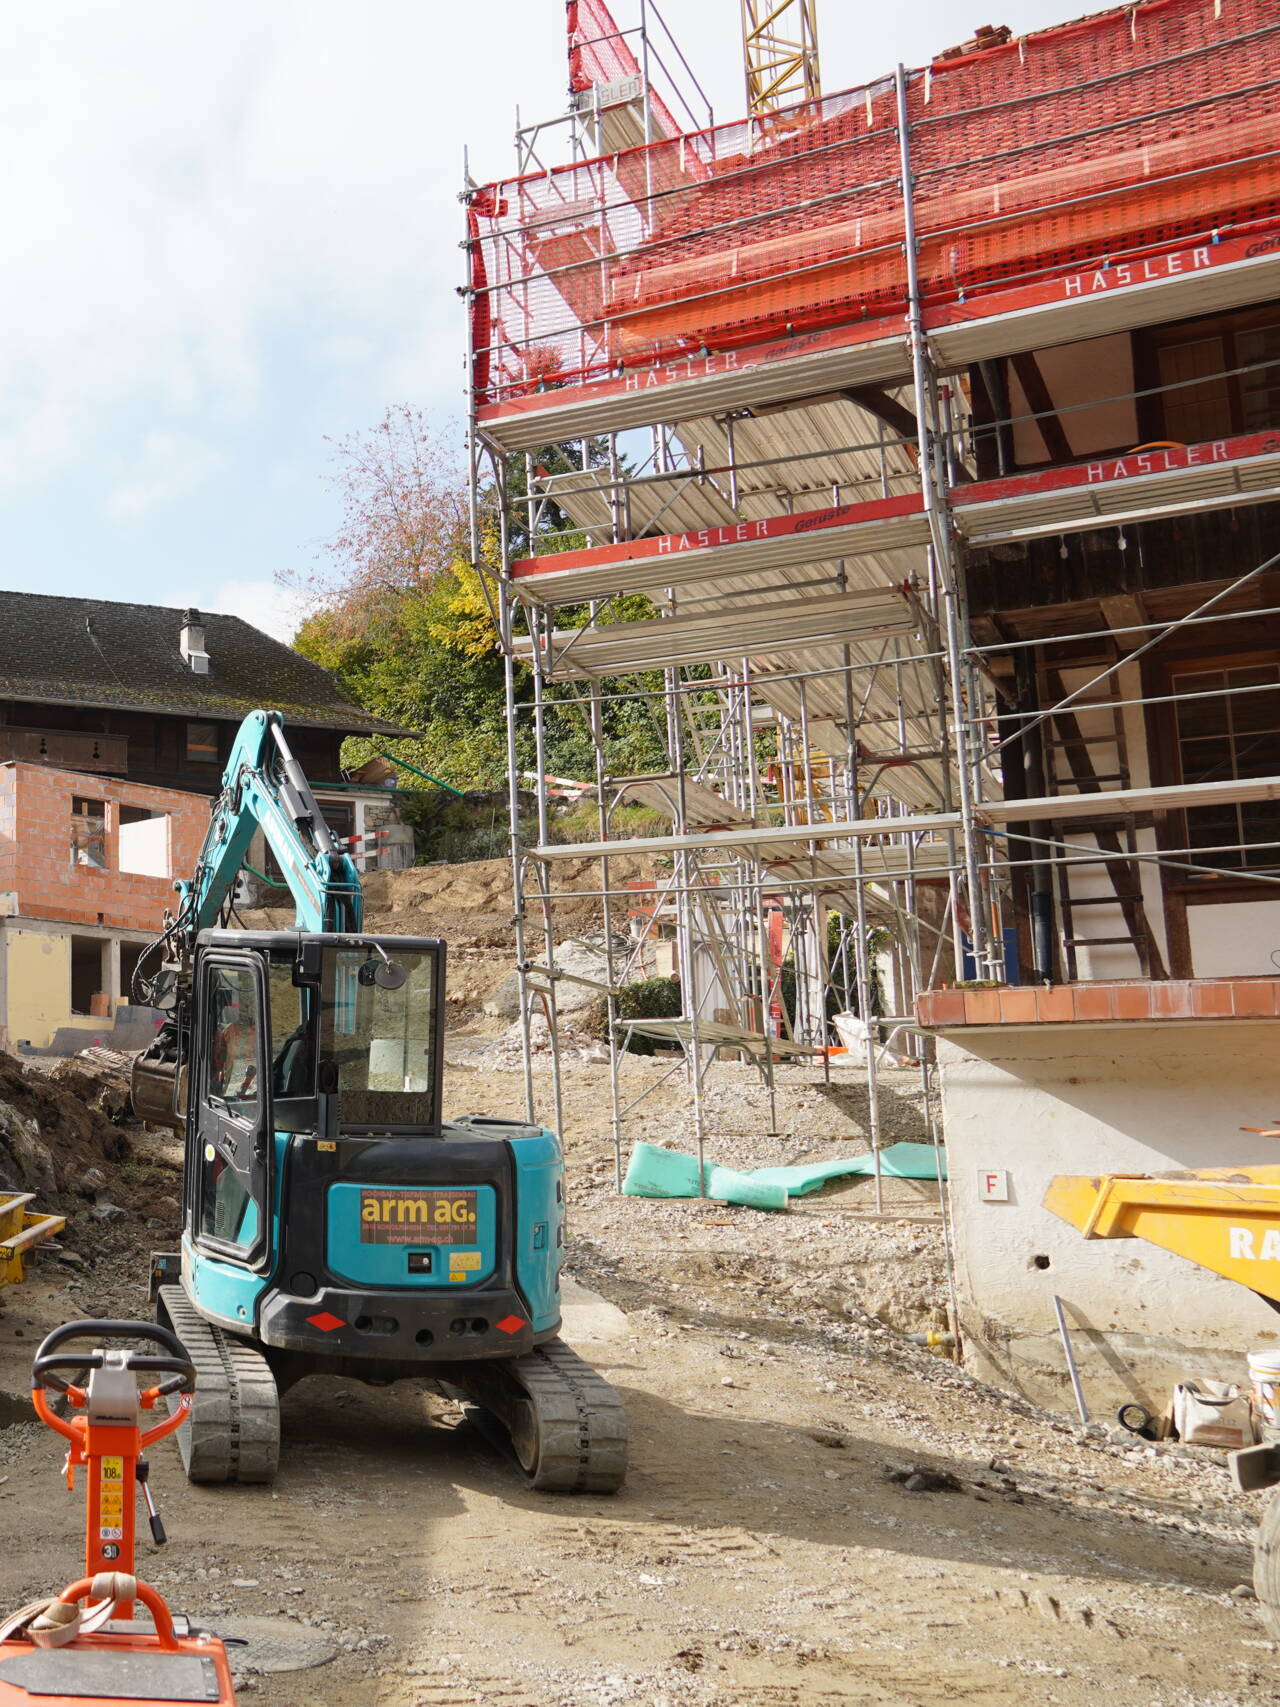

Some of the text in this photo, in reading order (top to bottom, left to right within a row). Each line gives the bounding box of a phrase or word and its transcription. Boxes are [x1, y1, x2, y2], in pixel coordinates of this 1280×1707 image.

[1065, 247, 1210, 296] HASLER
[625, 351, 738, 391] HASLER
[1088, 441, 1228, 482] HASLER
[659, 505, 851, 553] HASLER Gerüste
[986, 1175, 998, 1193] F
[361, 1198, 428, 1223] arm
[104, 1467, 117, 1479] 108
